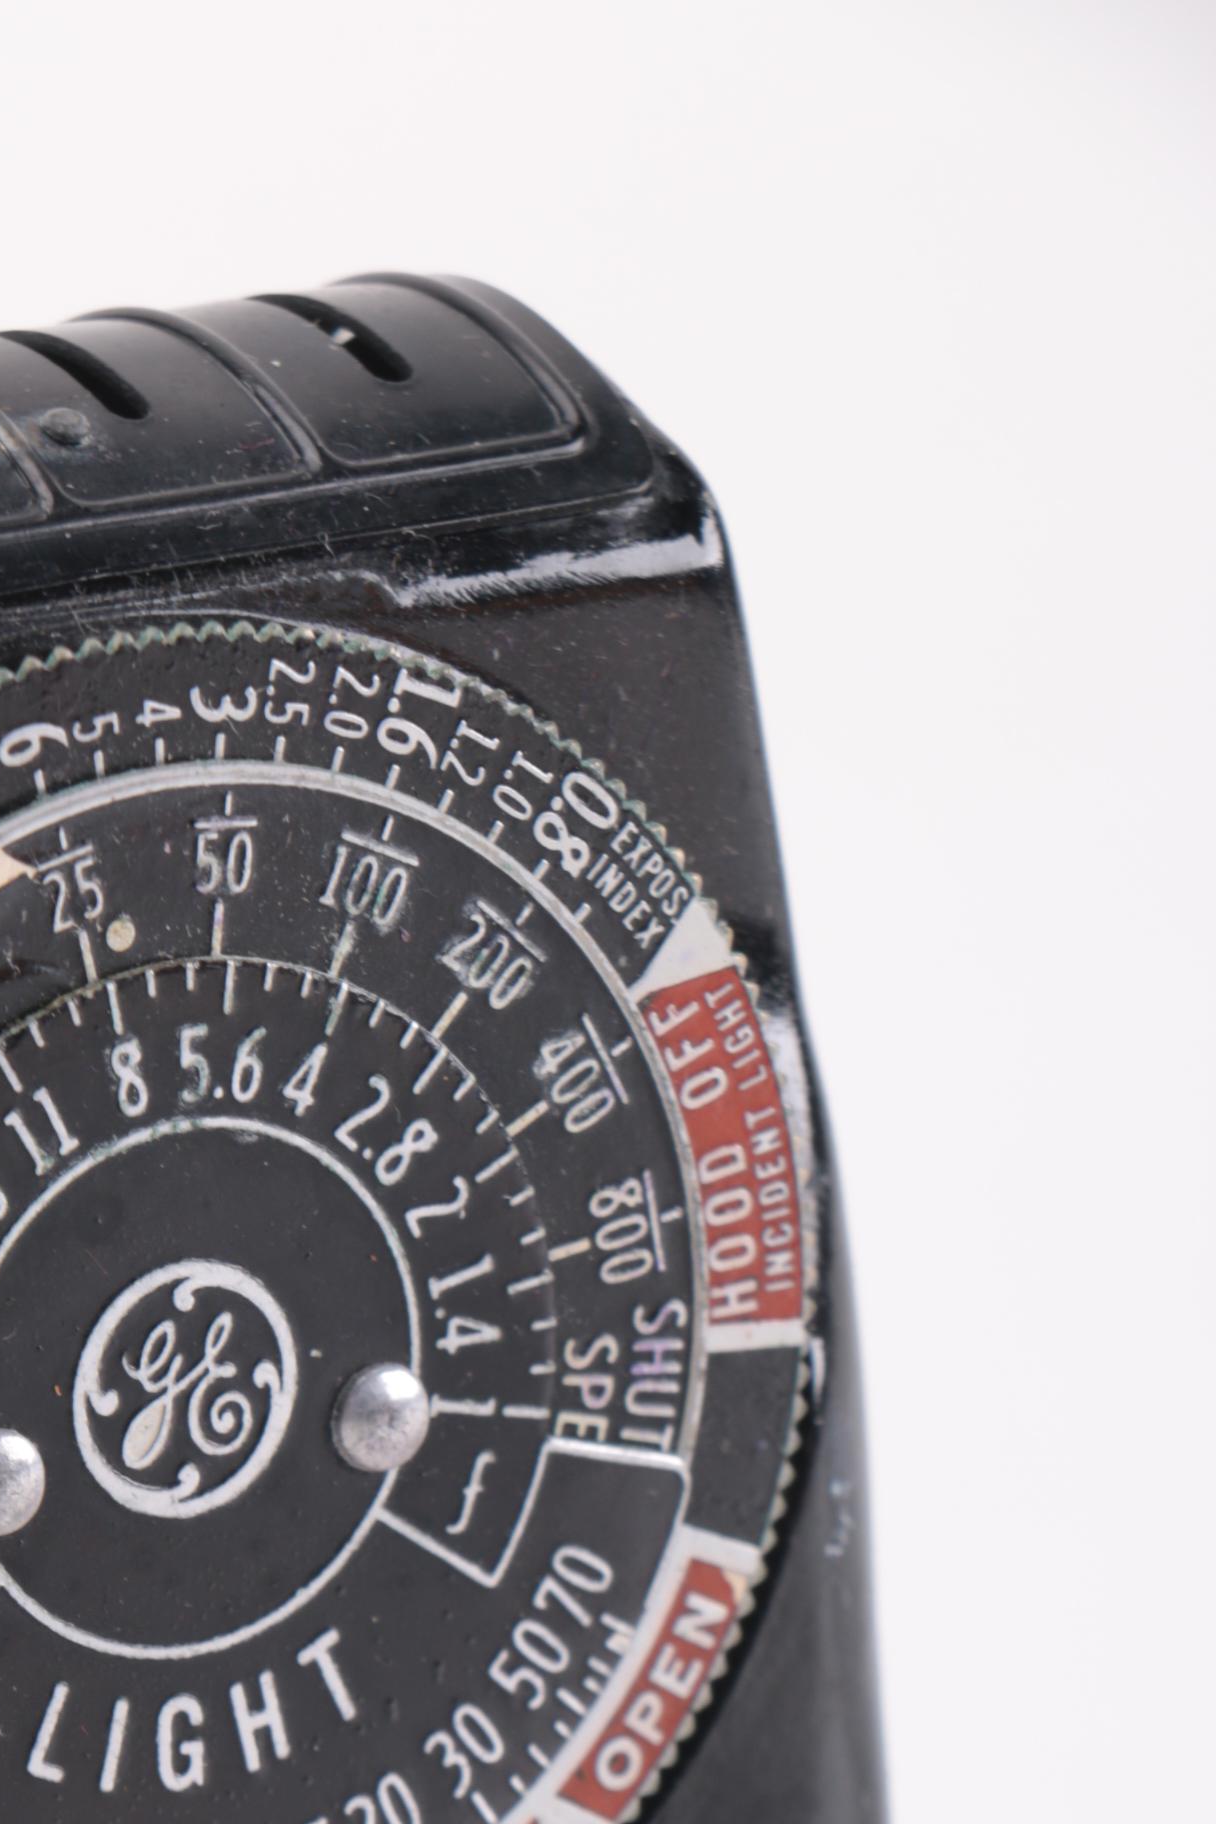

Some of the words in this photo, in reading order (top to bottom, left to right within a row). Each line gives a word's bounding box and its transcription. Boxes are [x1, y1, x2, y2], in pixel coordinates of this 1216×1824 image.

[73, 712, 120, 742] 5
[136, 700, 181, 727] 4
[190, 687, 257, 722] 3
[265, 658, 315, 726] 2.5
[324, 666, 380, 739] 2.0
[377, 668, 462, 769] 1.6
[441, 720, 500, 786] 1.2
[493, 751, 553, 820] 1.0
[533, 772, 619, 878] 0.8
[586, 854, 665, 949] INDEX
[111, 1036, 149, 1118] 8
[179, 1022, 268, 1103] 5.6
[283, 1043, 328, 1117] 4
[649, 1001, 730, 1110] OFF
[704, 981, 768, 1091] LIGHT
[5, 1087, 80, 1176] 11
[334, 1074, 438, 1185] 2.8
[405, 1175, 469, 1239] 2
[698, 1144, 760, 1319] HOOD
[745, 1106, 794, 1292] INCIDENT
[428, 1254, 502, 1354] 1.4
[533, 1545, 614, 1628] 70
[489, 1620, 571, 1711] 50
[594, 1592, 729, 1793] OPEN
[27, 1629, 357, 1793] LIGHT
[424, 1704, 505, 1799] 30
